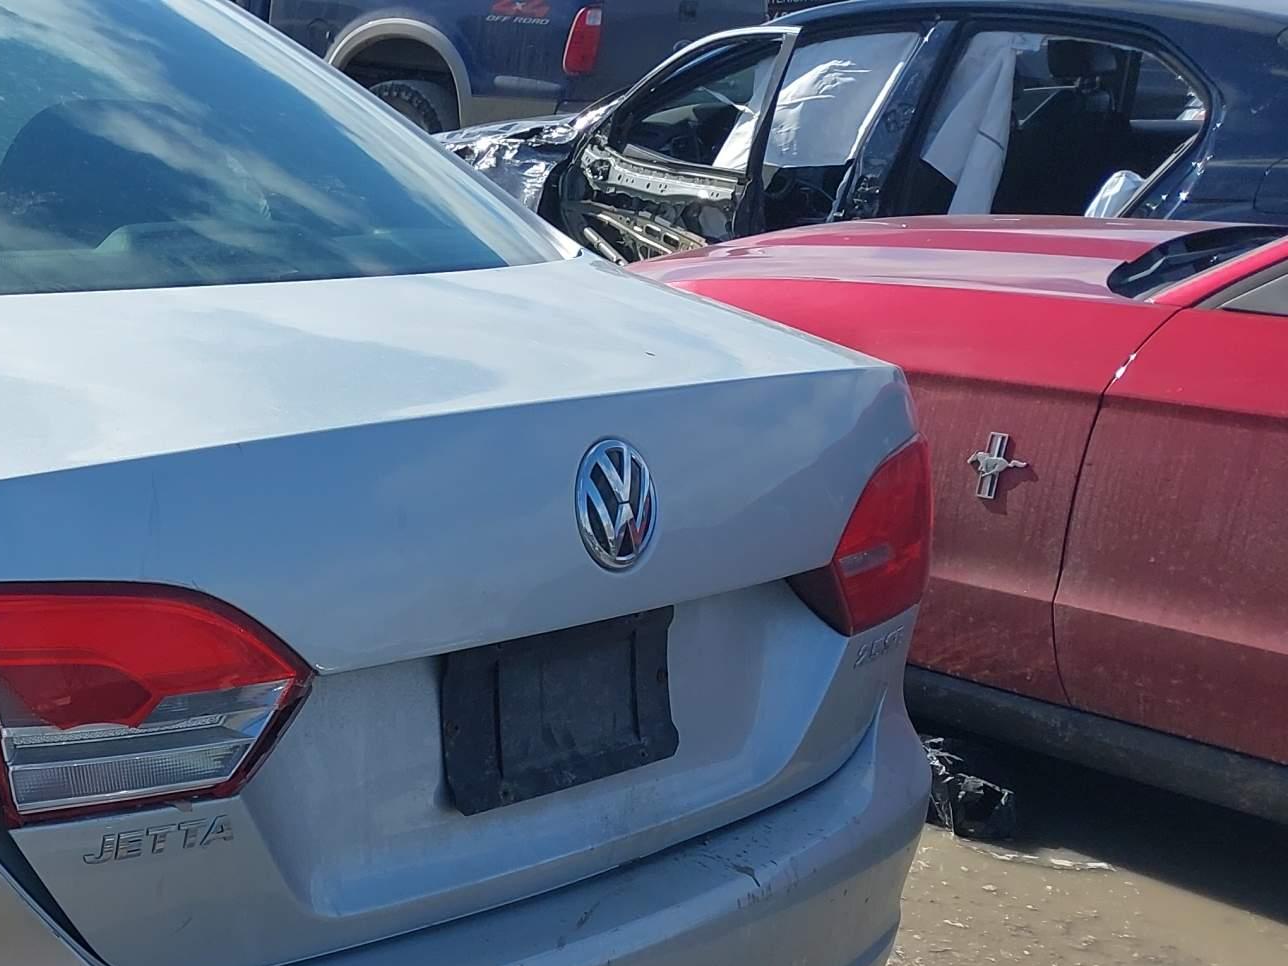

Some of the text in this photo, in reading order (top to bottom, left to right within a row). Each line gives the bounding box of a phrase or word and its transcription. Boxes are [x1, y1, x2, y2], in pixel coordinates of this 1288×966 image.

[486, 14, 550, 25] OFF ROAD
[83, 814, 234, 864] JETTA
